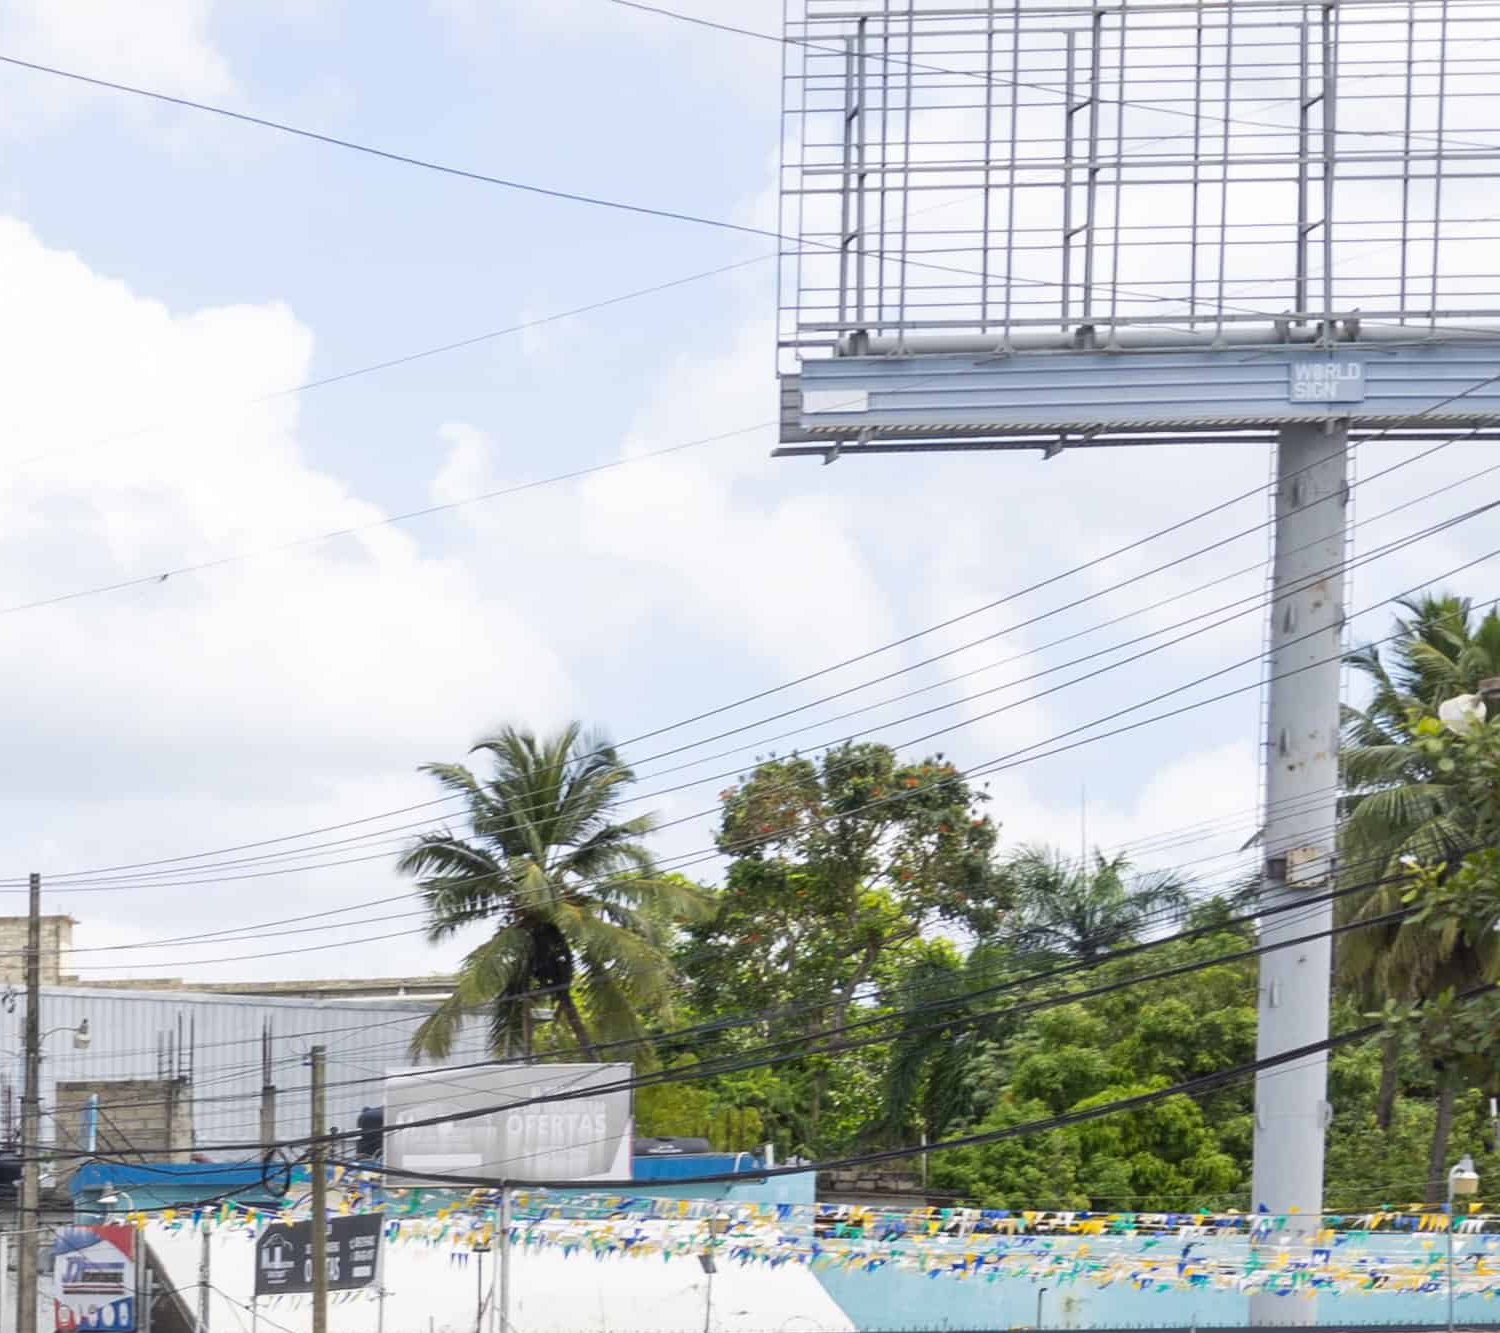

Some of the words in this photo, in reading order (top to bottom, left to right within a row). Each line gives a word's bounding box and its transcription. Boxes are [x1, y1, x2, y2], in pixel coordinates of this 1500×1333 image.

[1294, 362, 1361, 381] WORLD
[1293, 382, 1341, 400] SIGN
[505, 1113, 607, 1137] OFERTAS
